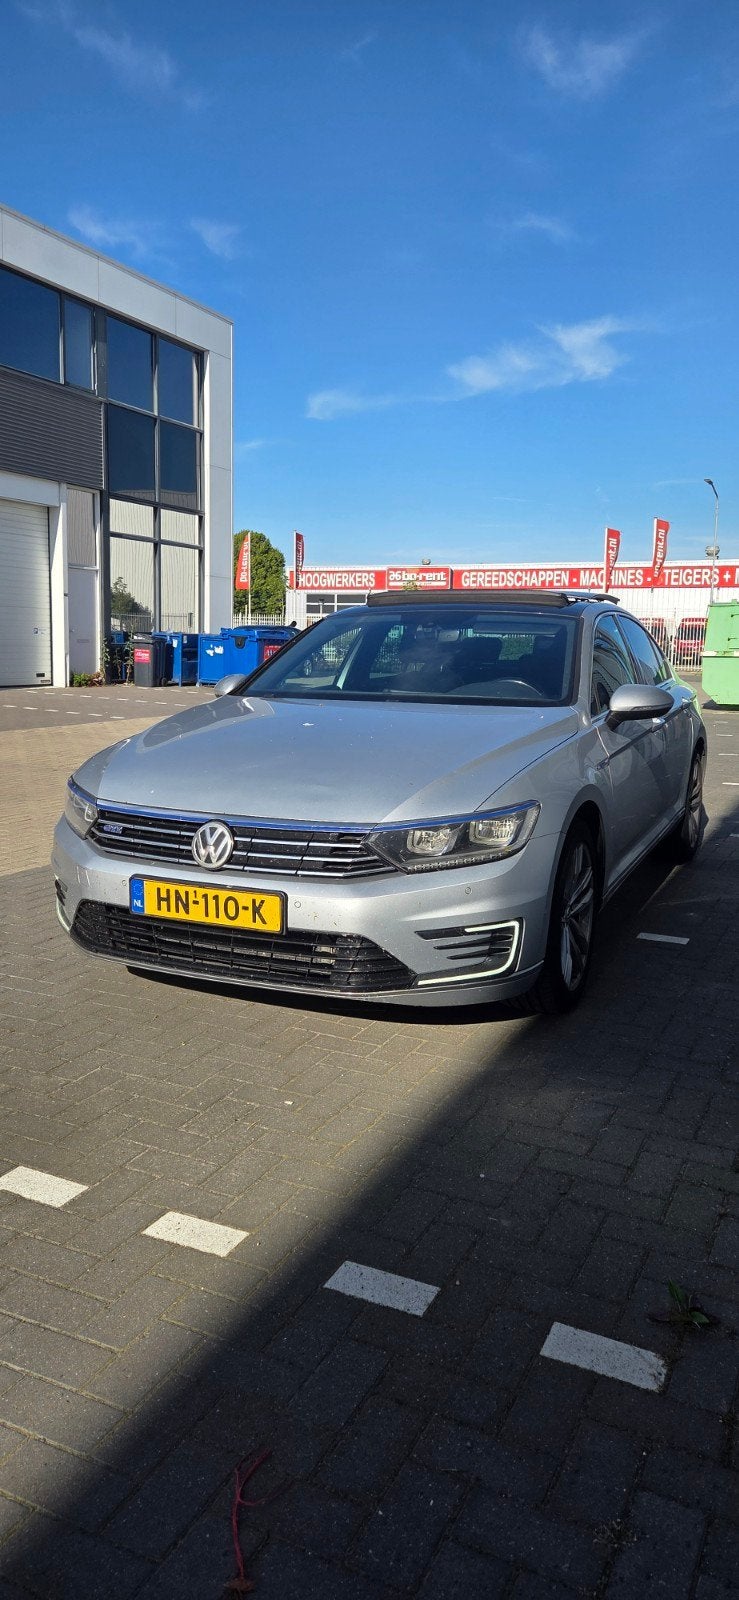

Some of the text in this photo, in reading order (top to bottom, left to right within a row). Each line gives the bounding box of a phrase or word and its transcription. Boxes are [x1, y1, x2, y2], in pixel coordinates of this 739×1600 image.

[299, 572, 375, 588] HOOGWERKERS
[402, 571, 447, 581] bo-rent
[461, 571, 569, 587] GEREEDSCHAPPEN
[656, 568, 719, 586] TEIGERS
[133, 899, 143, 908] NL
